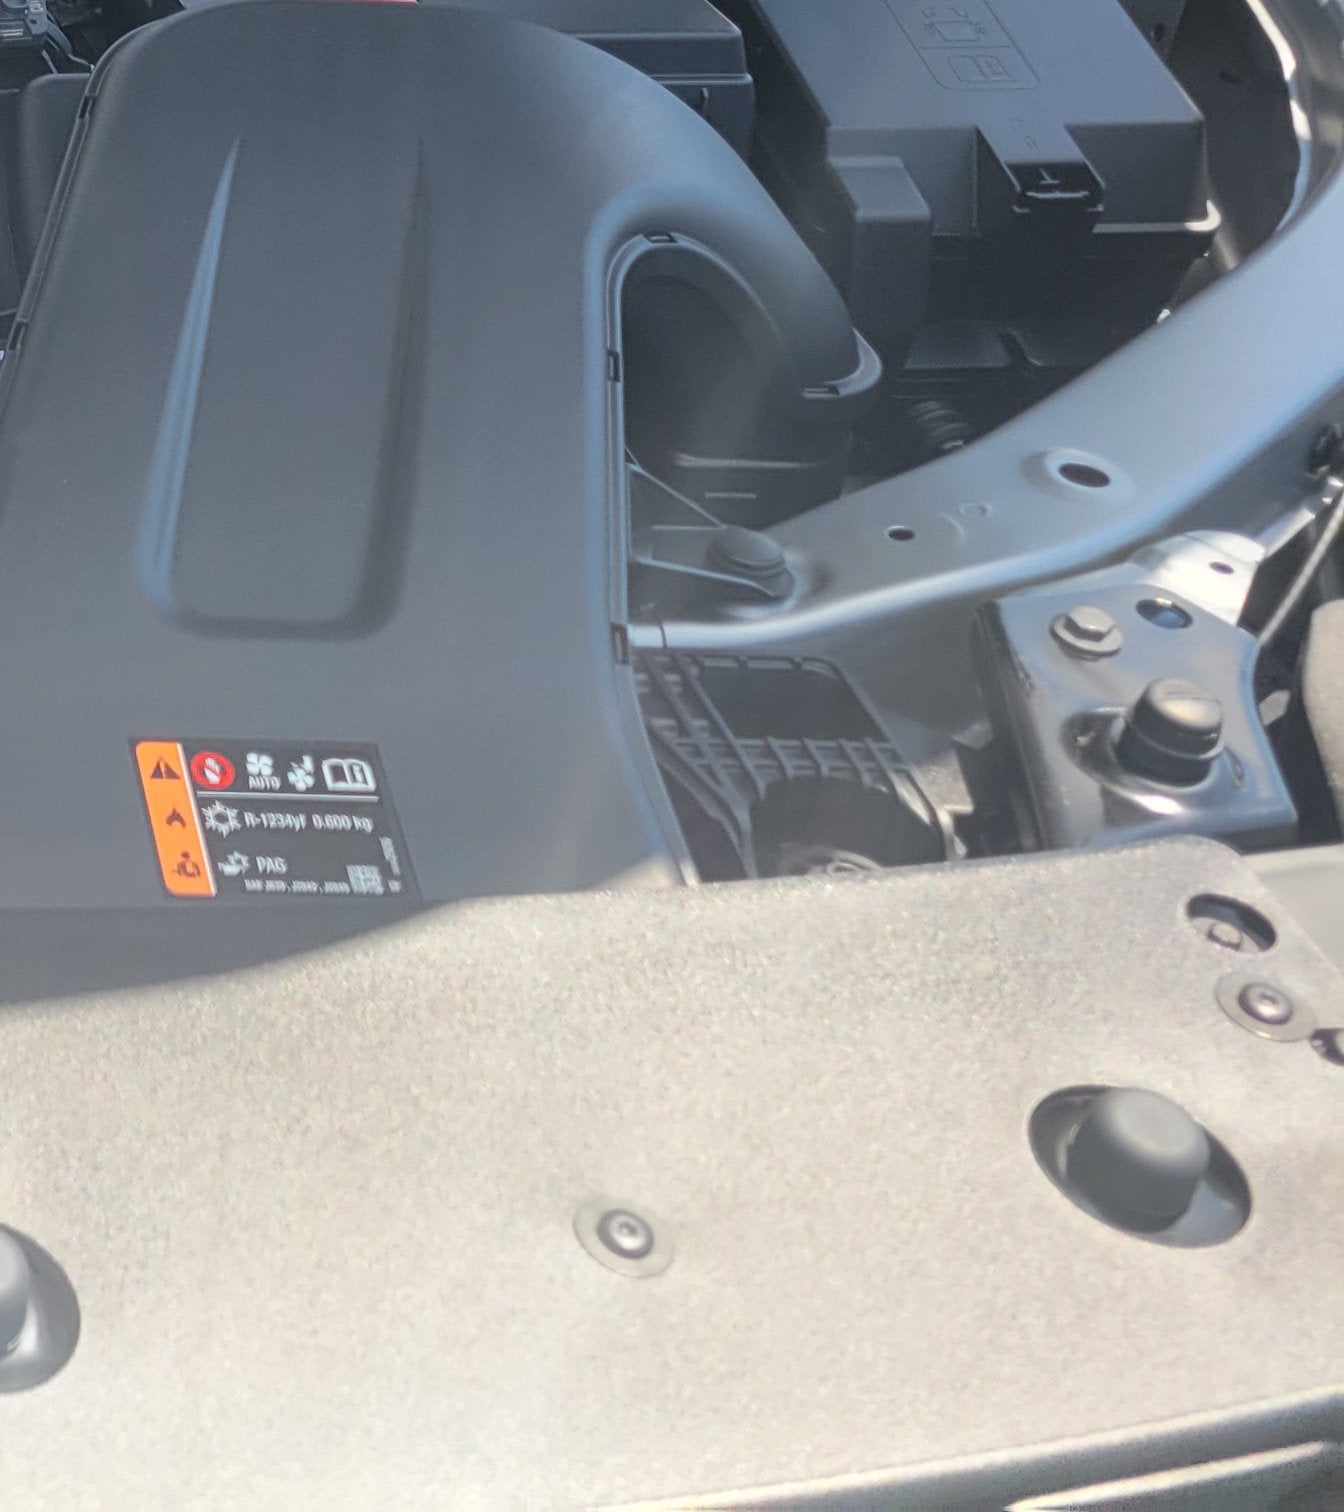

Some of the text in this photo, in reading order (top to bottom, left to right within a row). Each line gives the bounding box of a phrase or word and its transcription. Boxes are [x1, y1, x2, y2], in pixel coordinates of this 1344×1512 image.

[248, 775, 281, 791] AUTO
[311, 813, 352, 832] 0.600
[255, 855, 288, 875] PAG
